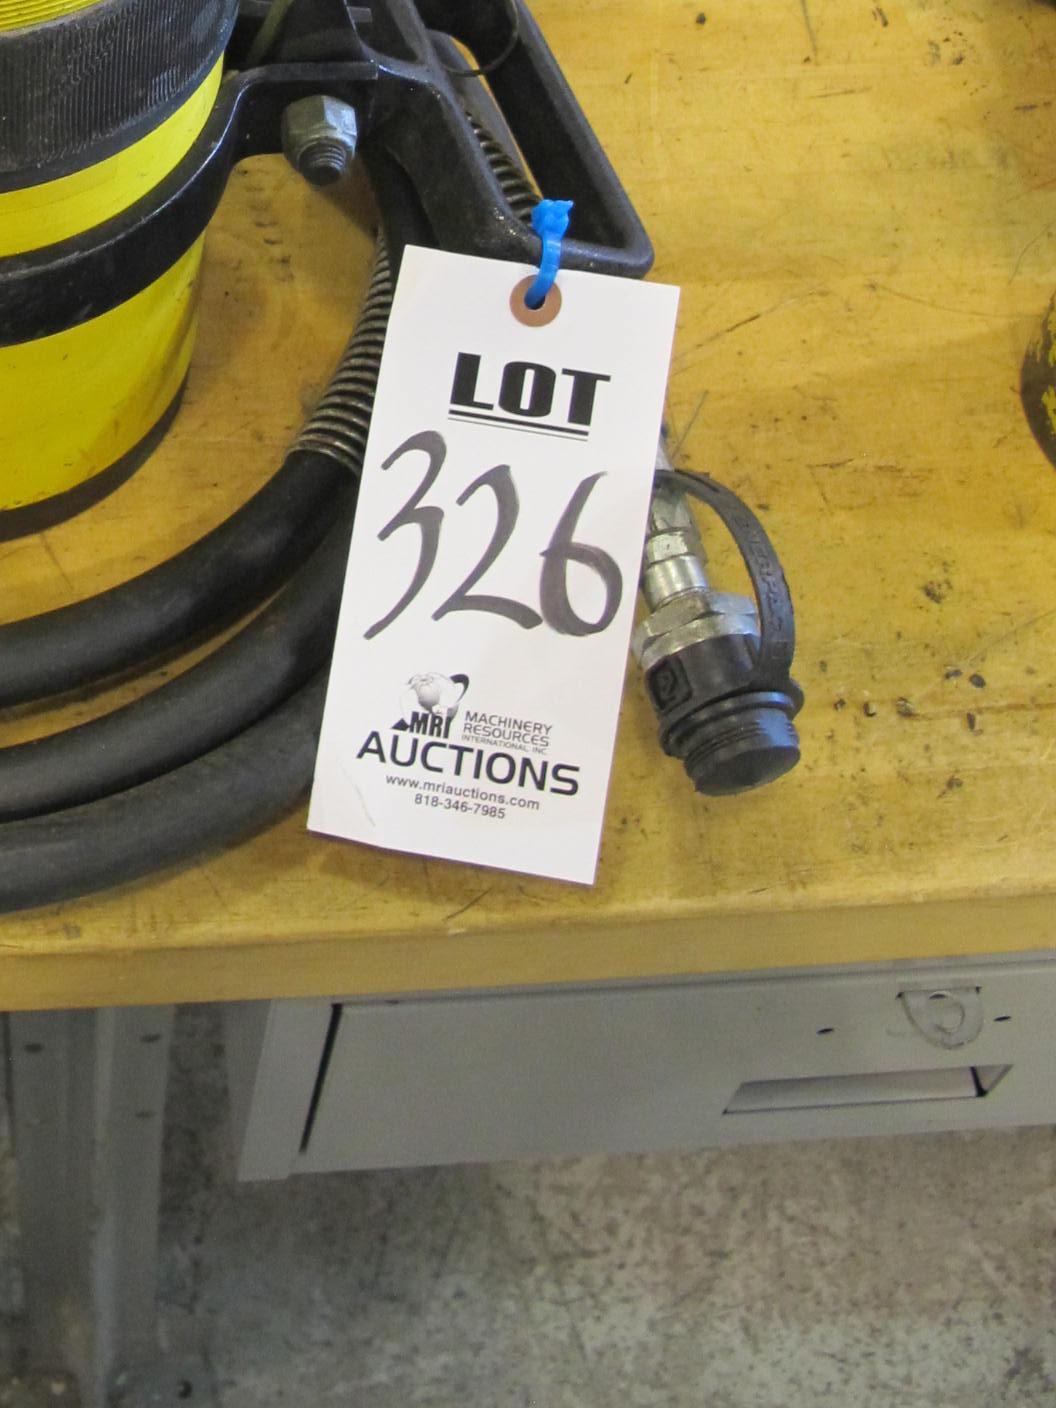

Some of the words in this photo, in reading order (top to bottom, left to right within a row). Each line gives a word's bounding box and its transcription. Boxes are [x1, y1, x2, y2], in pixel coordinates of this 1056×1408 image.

[450, 352, 611, 426] LOT
[363, 430, 624, 641] 326
[409, 710, 455, 739] MRI
[463, 722, 550, 747] RESOURCES
[465, 710, 553, 736] MACHINERY
[356, 730, 581, 796] AUCTIONS
[385, 775, 541, 810] www.mriauctions.com
[414, 793, 506, 819] 818-346-7985
